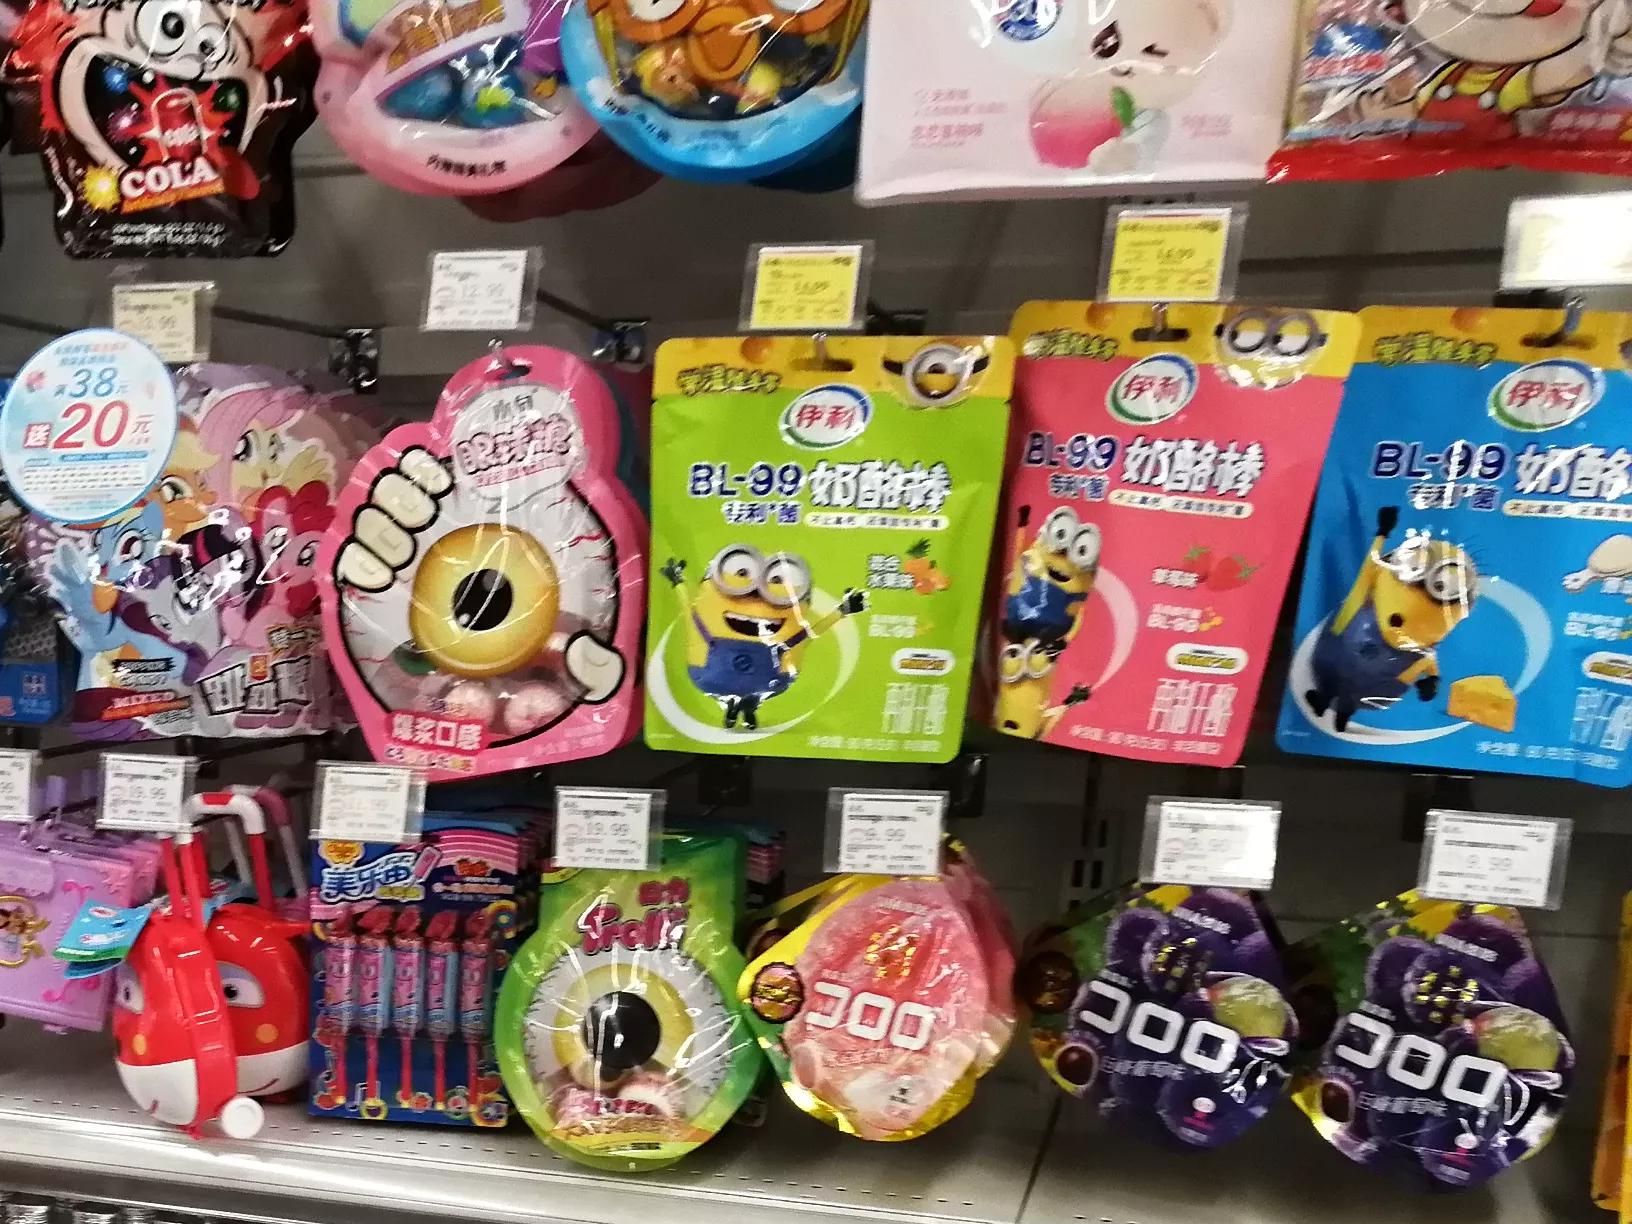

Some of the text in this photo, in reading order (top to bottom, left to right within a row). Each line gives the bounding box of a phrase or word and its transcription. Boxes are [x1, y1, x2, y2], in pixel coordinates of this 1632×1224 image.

[120, 155, 220, 199] COLA
[1124, 374, 1183, 404] 伊利
[795, 403, 859, 430] 伊利
[689, 458, 952, 514] BL-99 奶酪棒
[1023, 431, 1266, 498] BL-99 奶酪棒
